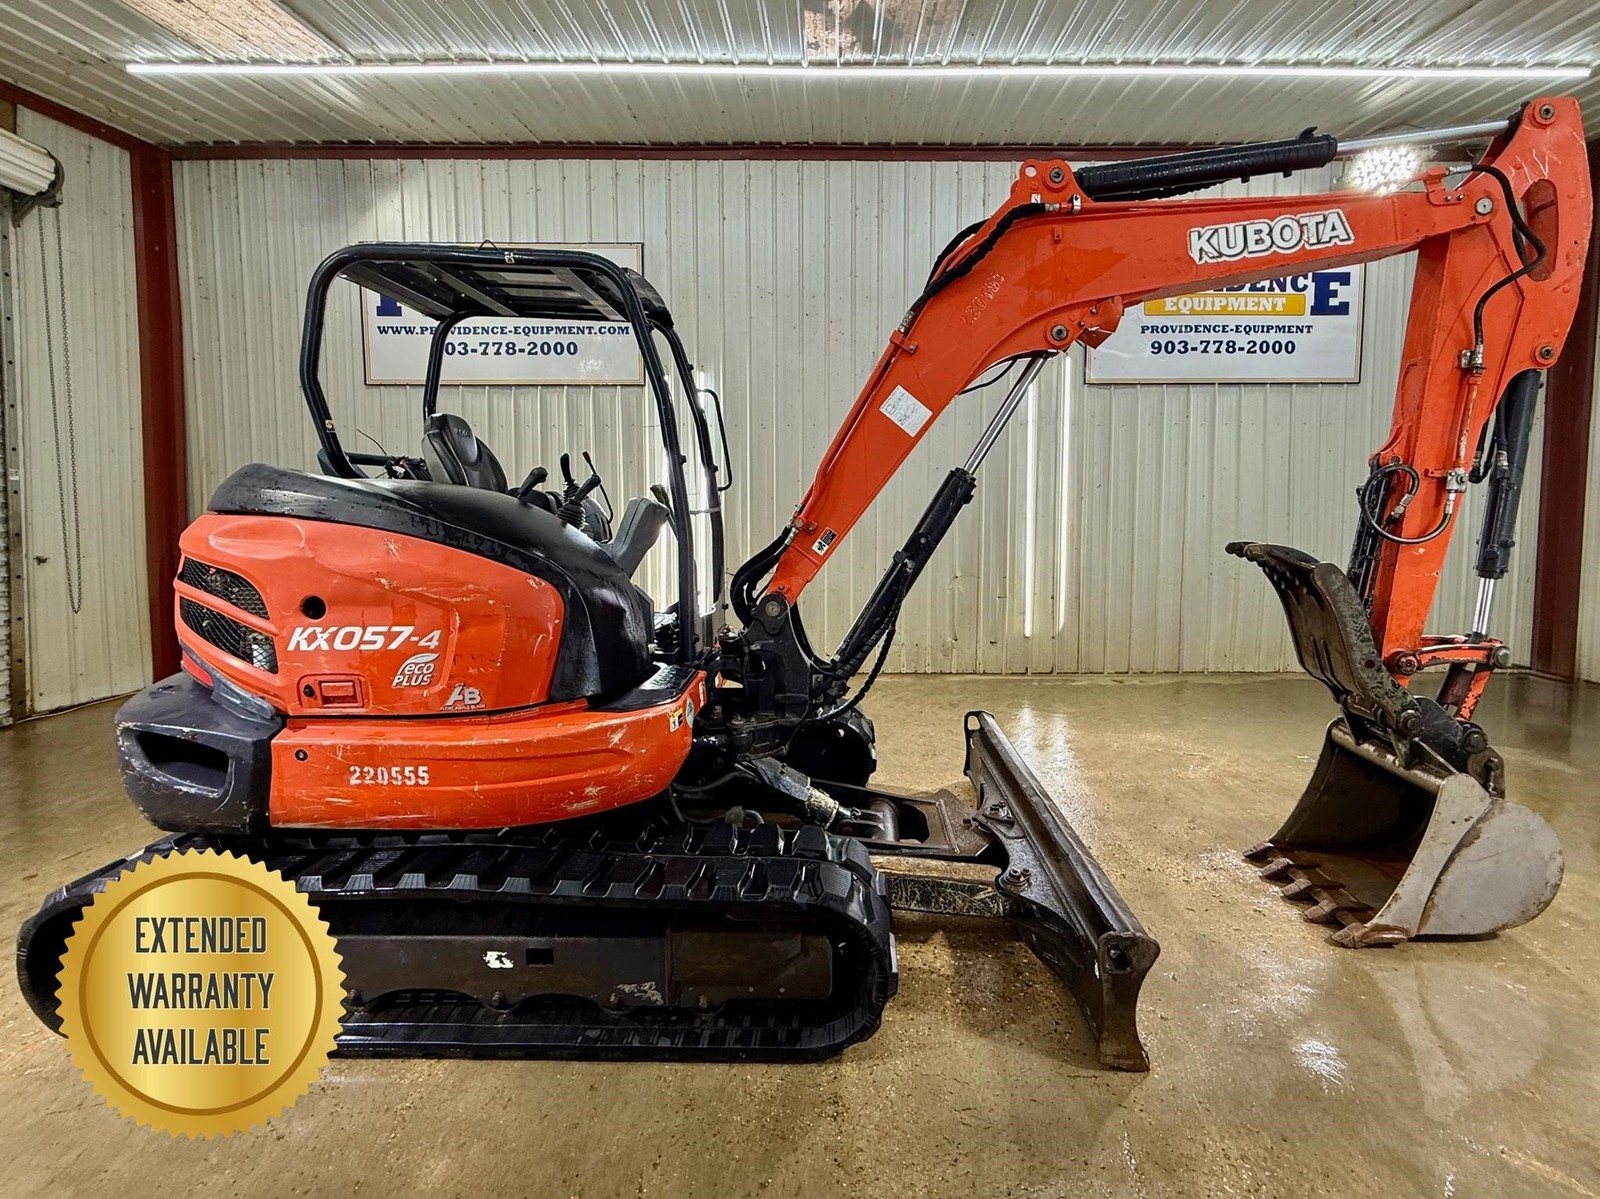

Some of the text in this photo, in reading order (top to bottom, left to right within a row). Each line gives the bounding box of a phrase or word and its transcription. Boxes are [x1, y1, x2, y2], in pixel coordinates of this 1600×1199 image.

[1188, 209, 1354, 263] KUBOTA
[1164, 296, 1286, 312] EQUIPMENT
[376, 325, 630, 337] WWW.PRVIDENCE-EQUIPMENT.COM
[1140, 324, 1313, 335] PROVIDENCE-EQUIPMENT
[444, 341, 579, 356] 03-778-2000
[1150, 340, 1297, 355] 903-778-2000
[287, 626, 442, 651] KX057-4
[404, 663, 435, 674] eco
[392, 674, 433, 688] PLUS
[349, 765, 430, 786] 220555
